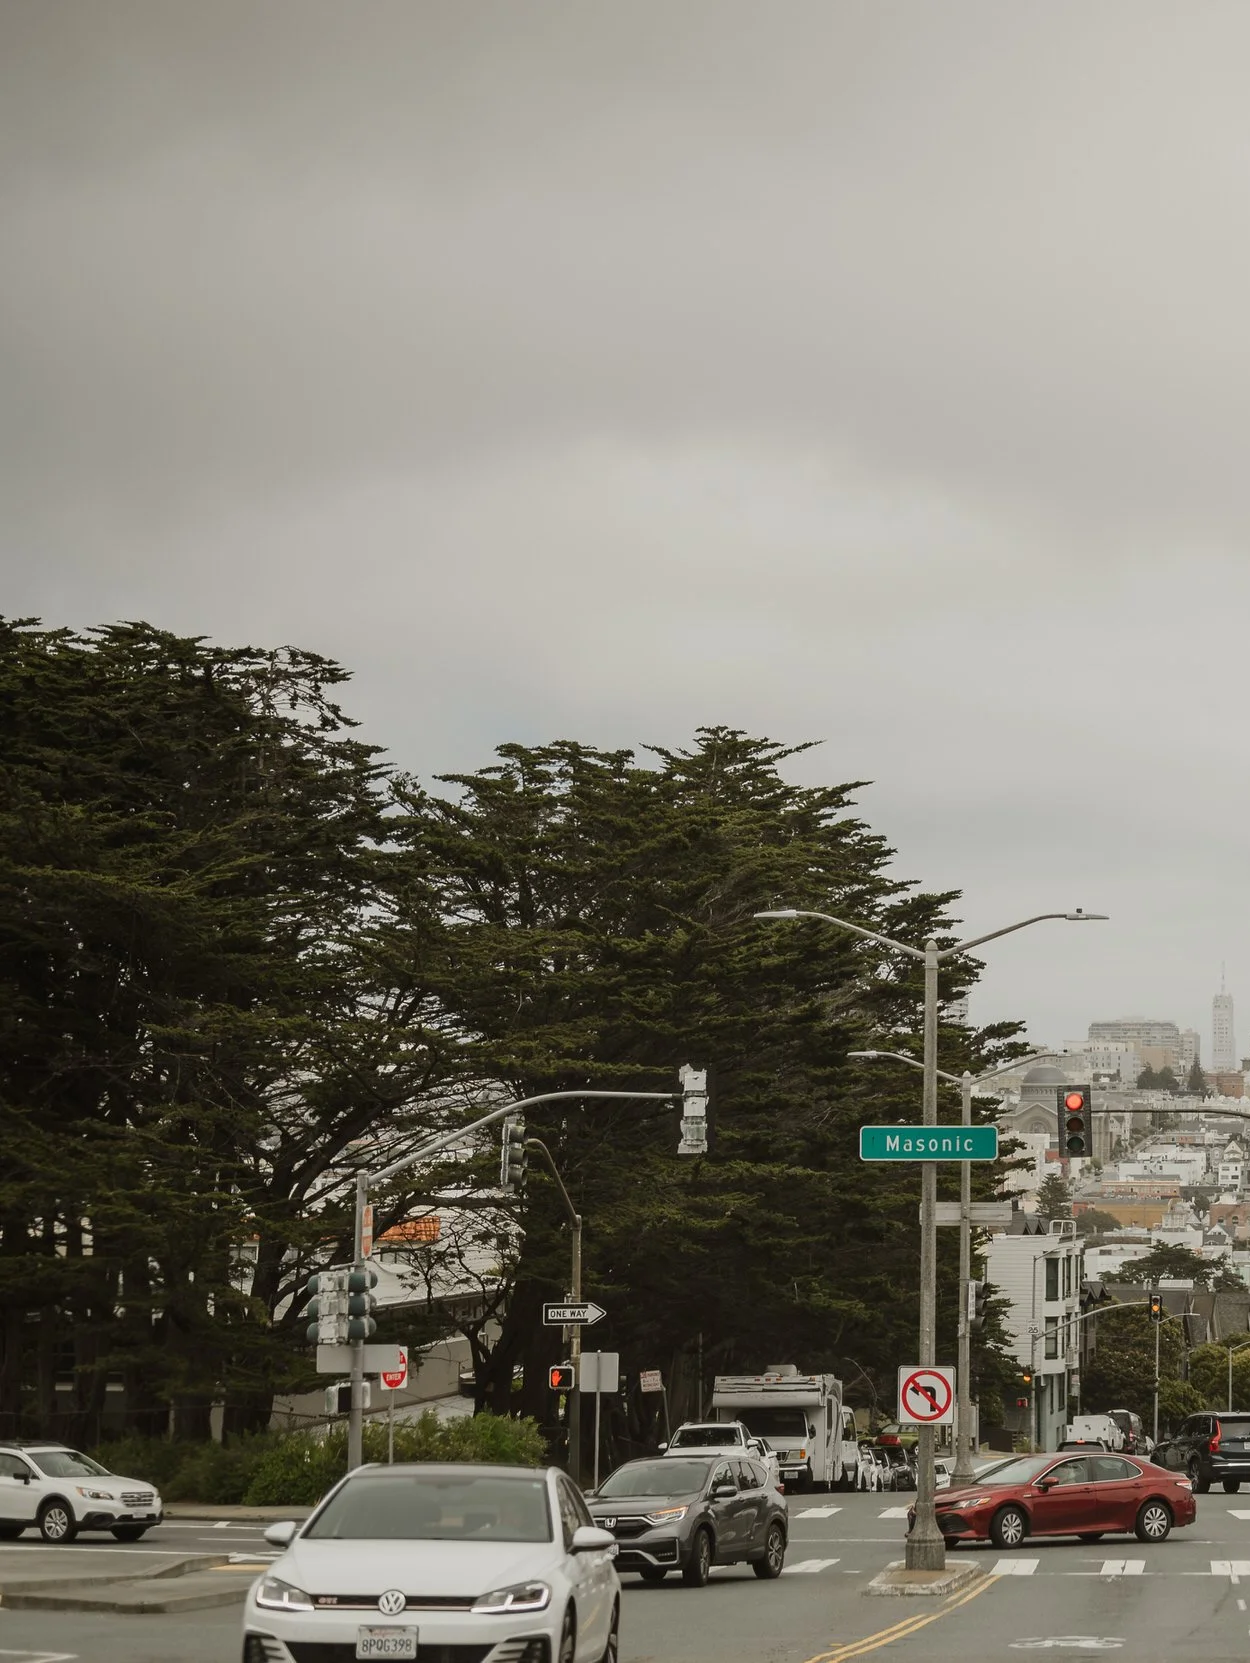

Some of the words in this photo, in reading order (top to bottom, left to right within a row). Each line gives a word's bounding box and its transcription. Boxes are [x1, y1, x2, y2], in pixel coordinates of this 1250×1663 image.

[886, 1135, 973, 1152] Masonic
[550, 1310, 567, 1318] ONE
[570, 1310, 587, 1318] WAY
[1028, 1326, 1039, 1334] 25
